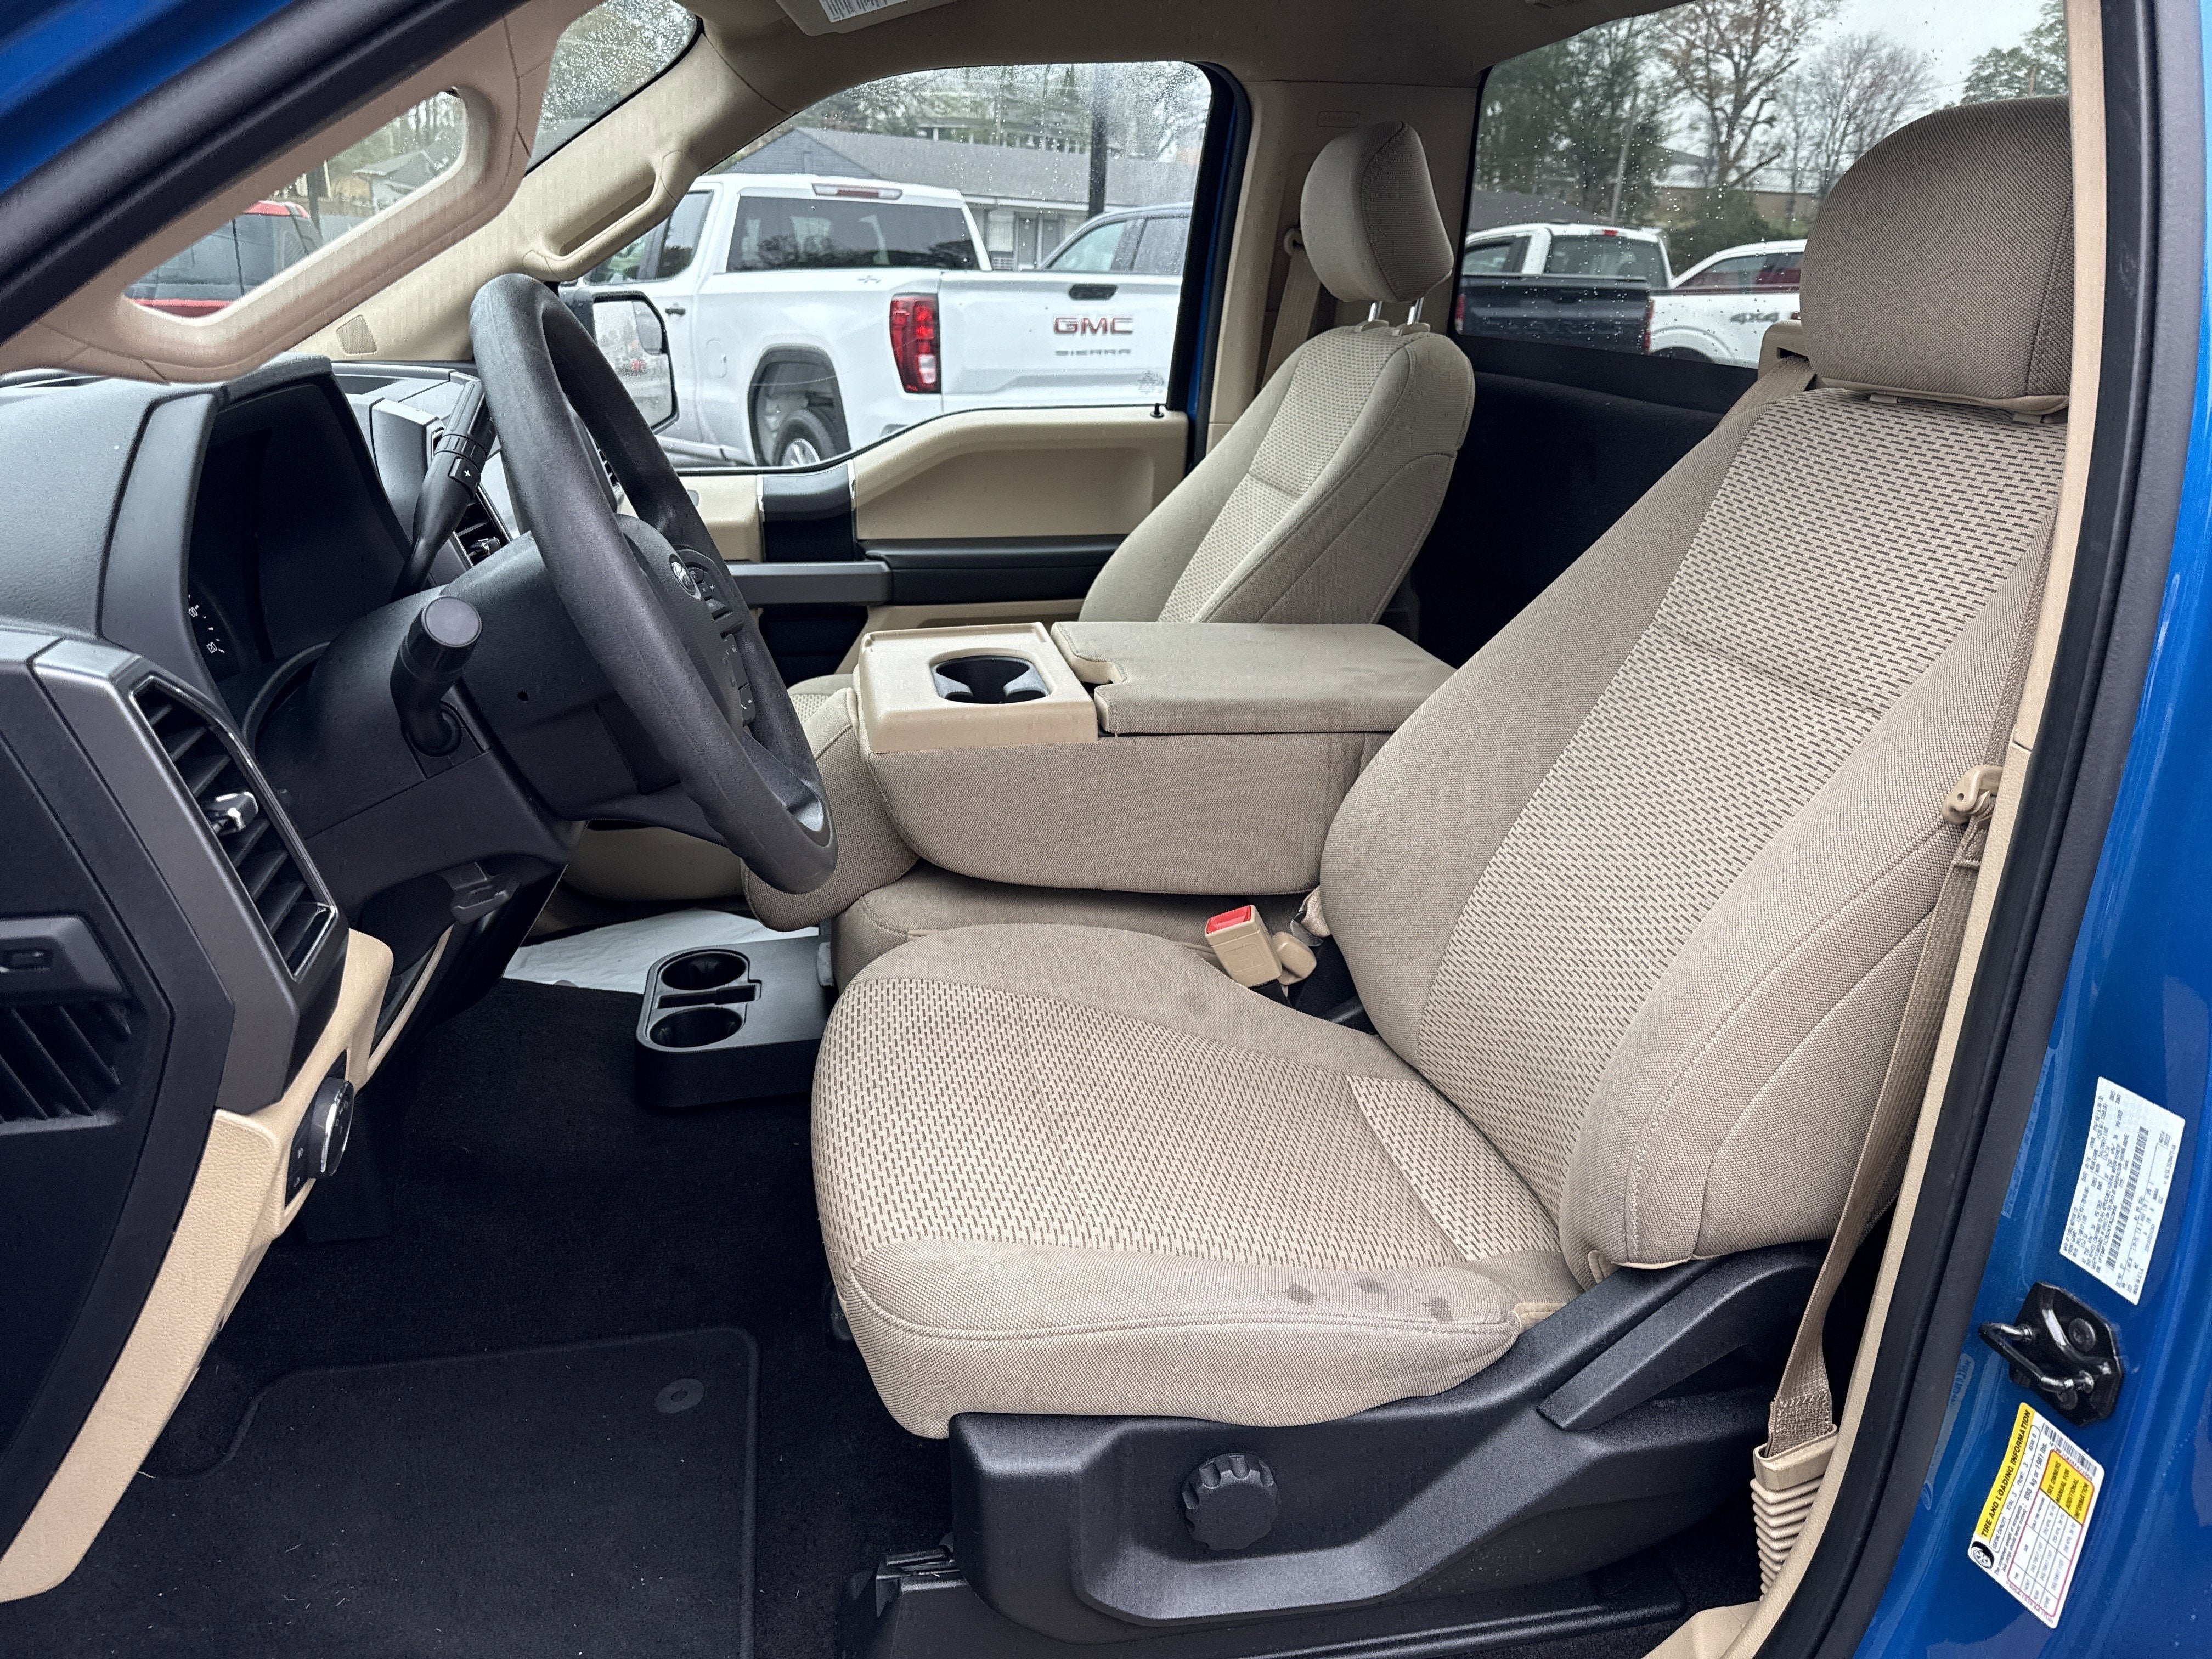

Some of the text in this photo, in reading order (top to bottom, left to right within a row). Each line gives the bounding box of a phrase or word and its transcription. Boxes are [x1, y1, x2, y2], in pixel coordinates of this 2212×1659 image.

[1054, 317, 1133, 335] GMC
[1981, 1409, 2032, 1538] TIRE AND LOADING INFORMATION
[2029, 1476, 2037, 1488] kg
[2033, 1469, 2039, 1477] or
[2039, 1440, 2047, 1454] lbs.
[2050, 1460, 2061, 1485] OWNERS
[2055, 1479, 2066, 1503] MANUAL
[2062, 1468, 2070, 1481] FOR
[2064, 1476, 2079, 1510] ADDITIONAL
[2073, 1481, 2089, 1519] INFORMATION
